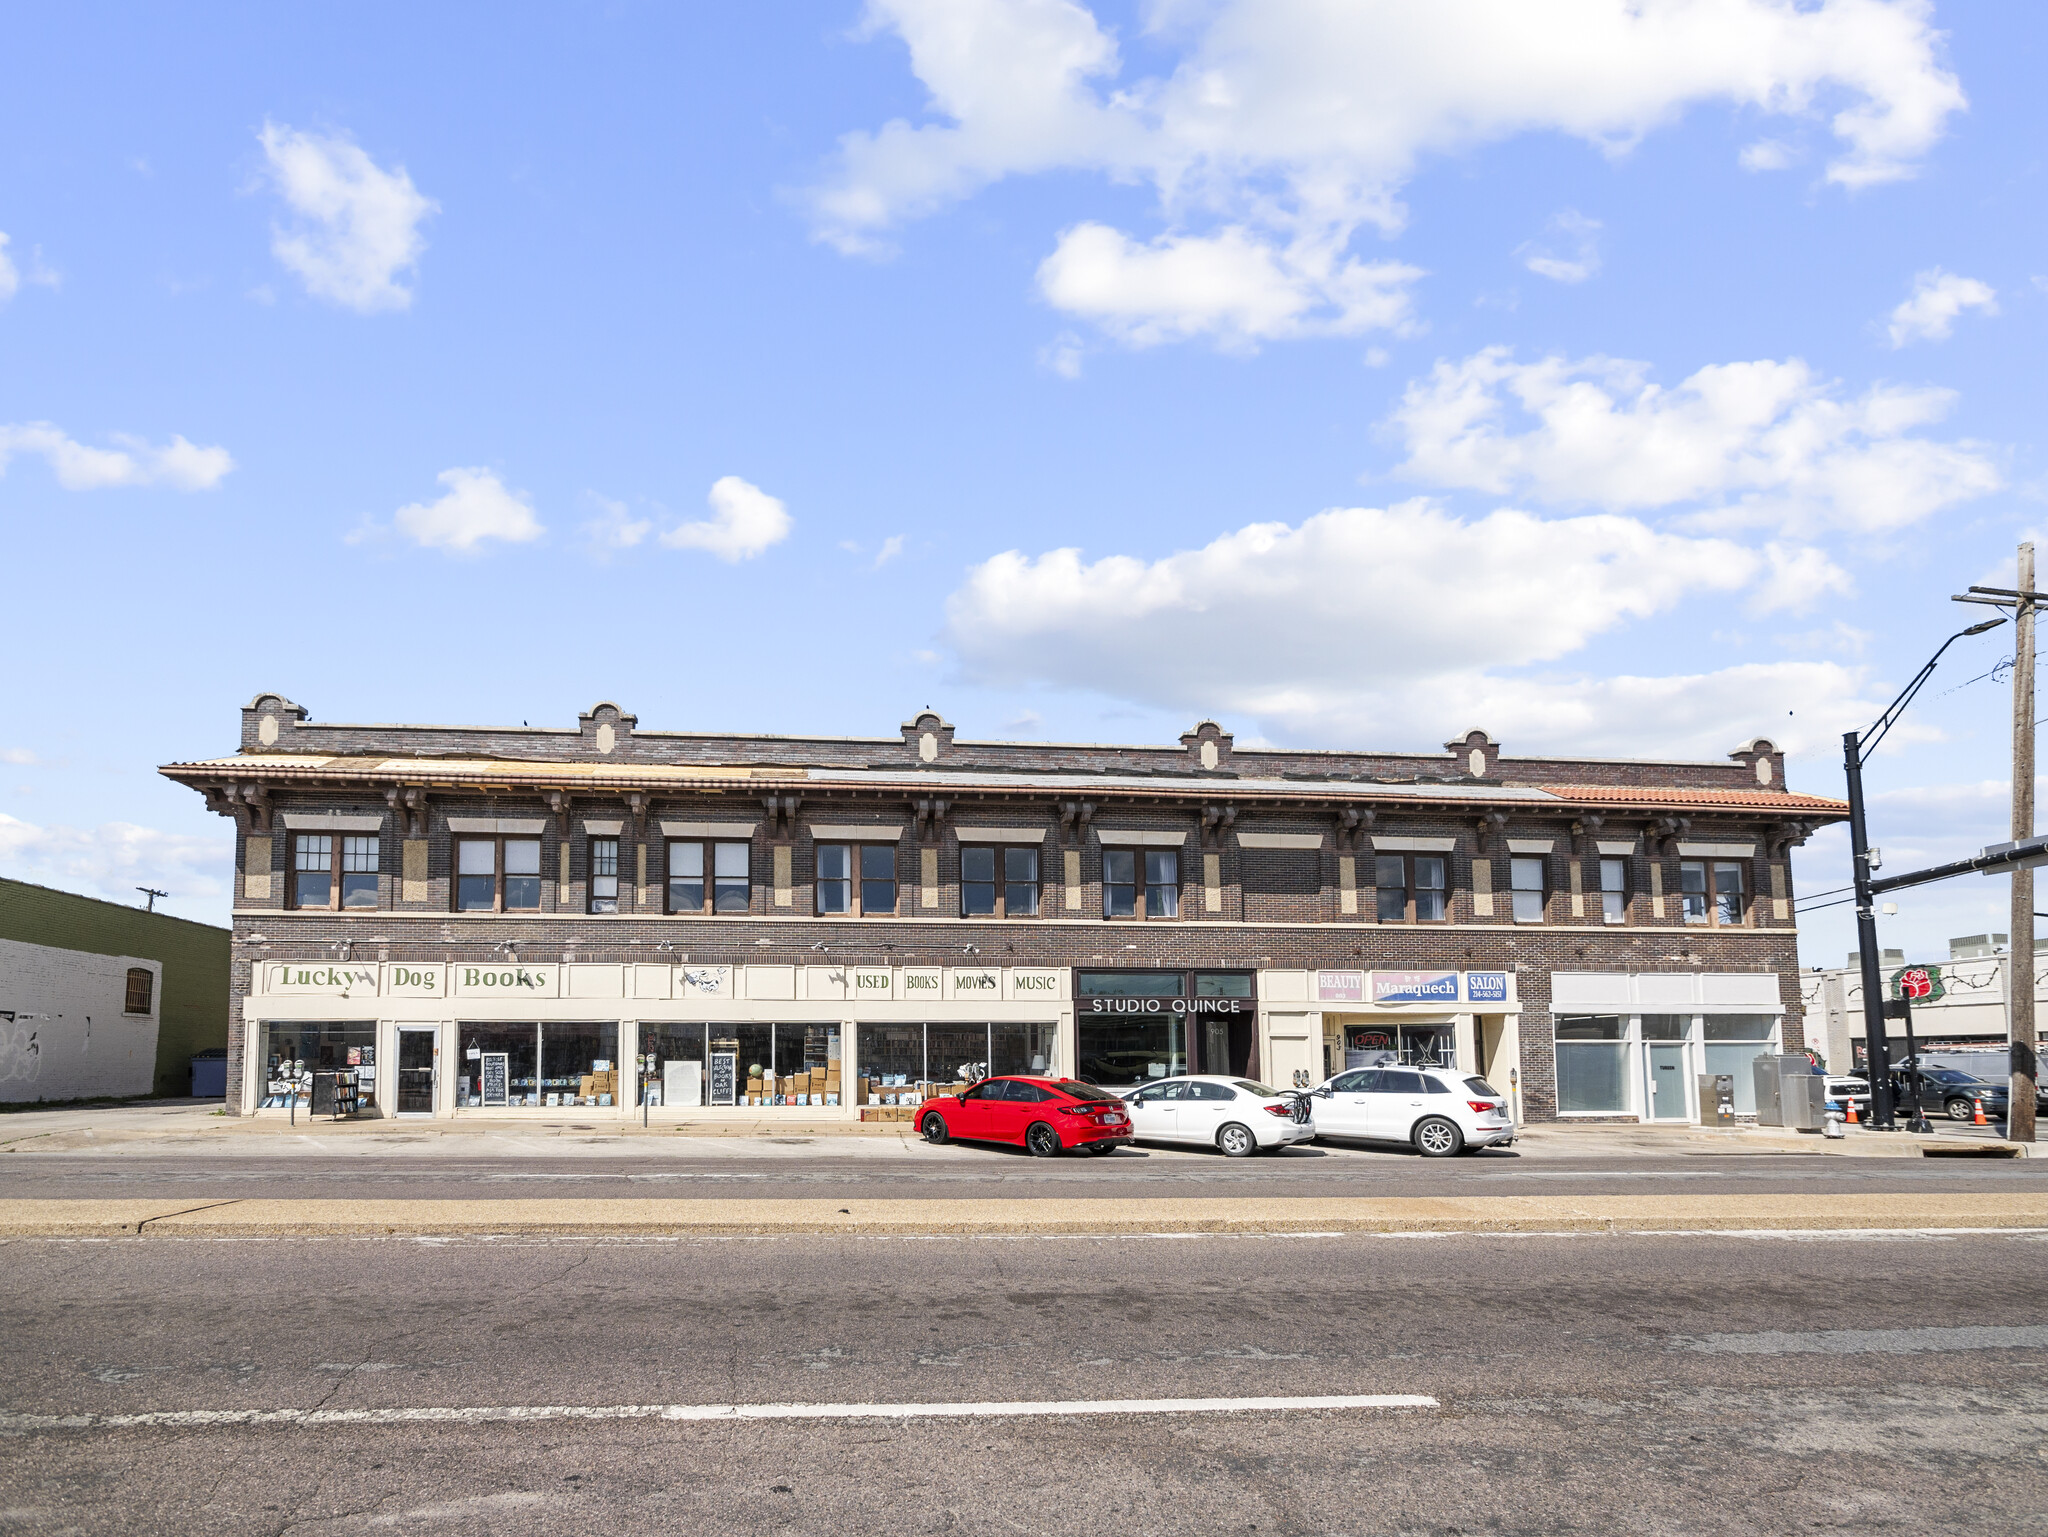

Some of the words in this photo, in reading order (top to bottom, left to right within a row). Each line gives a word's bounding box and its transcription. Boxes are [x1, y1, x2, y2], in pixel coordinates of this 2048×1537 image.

[280, 966, 358, 991] Lucky
[394, 967, 435, 990] Dog
[464, 968, 547, 987] Books
[856, 974, 889, 989] USED
[907, 975, 938, 989] BOOKS
[956, 975, 996, 989] MOVIES
[1015, 976, 1056, 990] MUSIC
[1319, 975, 1361, 989] BEAUTY
[1470, 976, 1504, 990] SALON
[1375, 981, 1456, 997] Maraquech
[1092, 999, 1161, 1013] STUDIO
[1171, 999, 1240, 1013] QUINCE
[1354, 1034, 1389, 1046] OPEN
